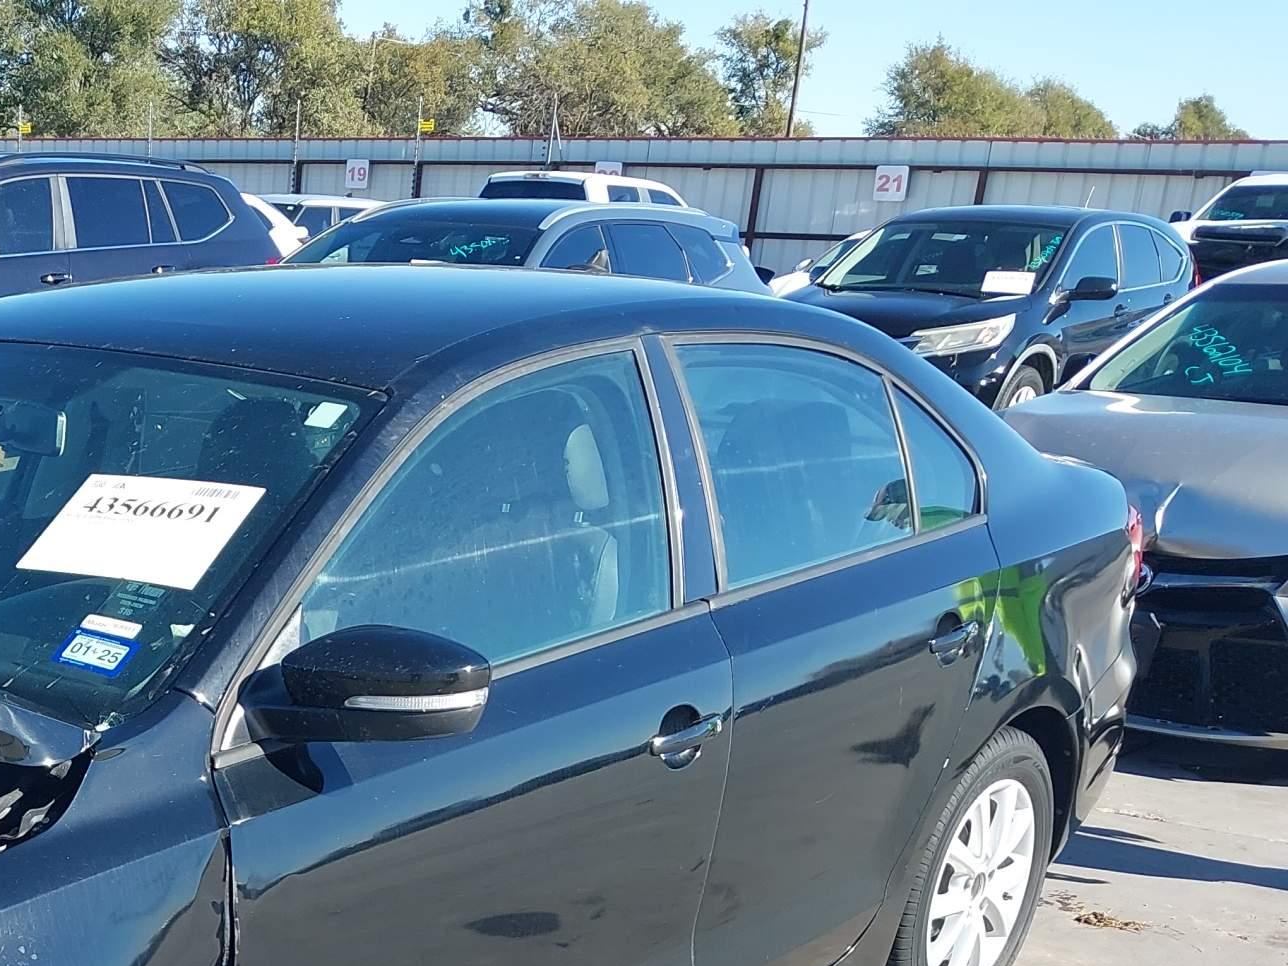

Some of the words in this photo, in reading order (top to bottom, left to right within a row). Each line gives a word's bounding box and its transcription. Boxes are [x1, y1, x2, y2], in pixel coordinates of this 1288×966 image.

[348, 166, 367, 182] 19
[875, 174, 903, 193] 21
[82, 495, 221, 524] 43566691
[69, 641, 92, 656] 01
[96, 649, 123, 664] 25
